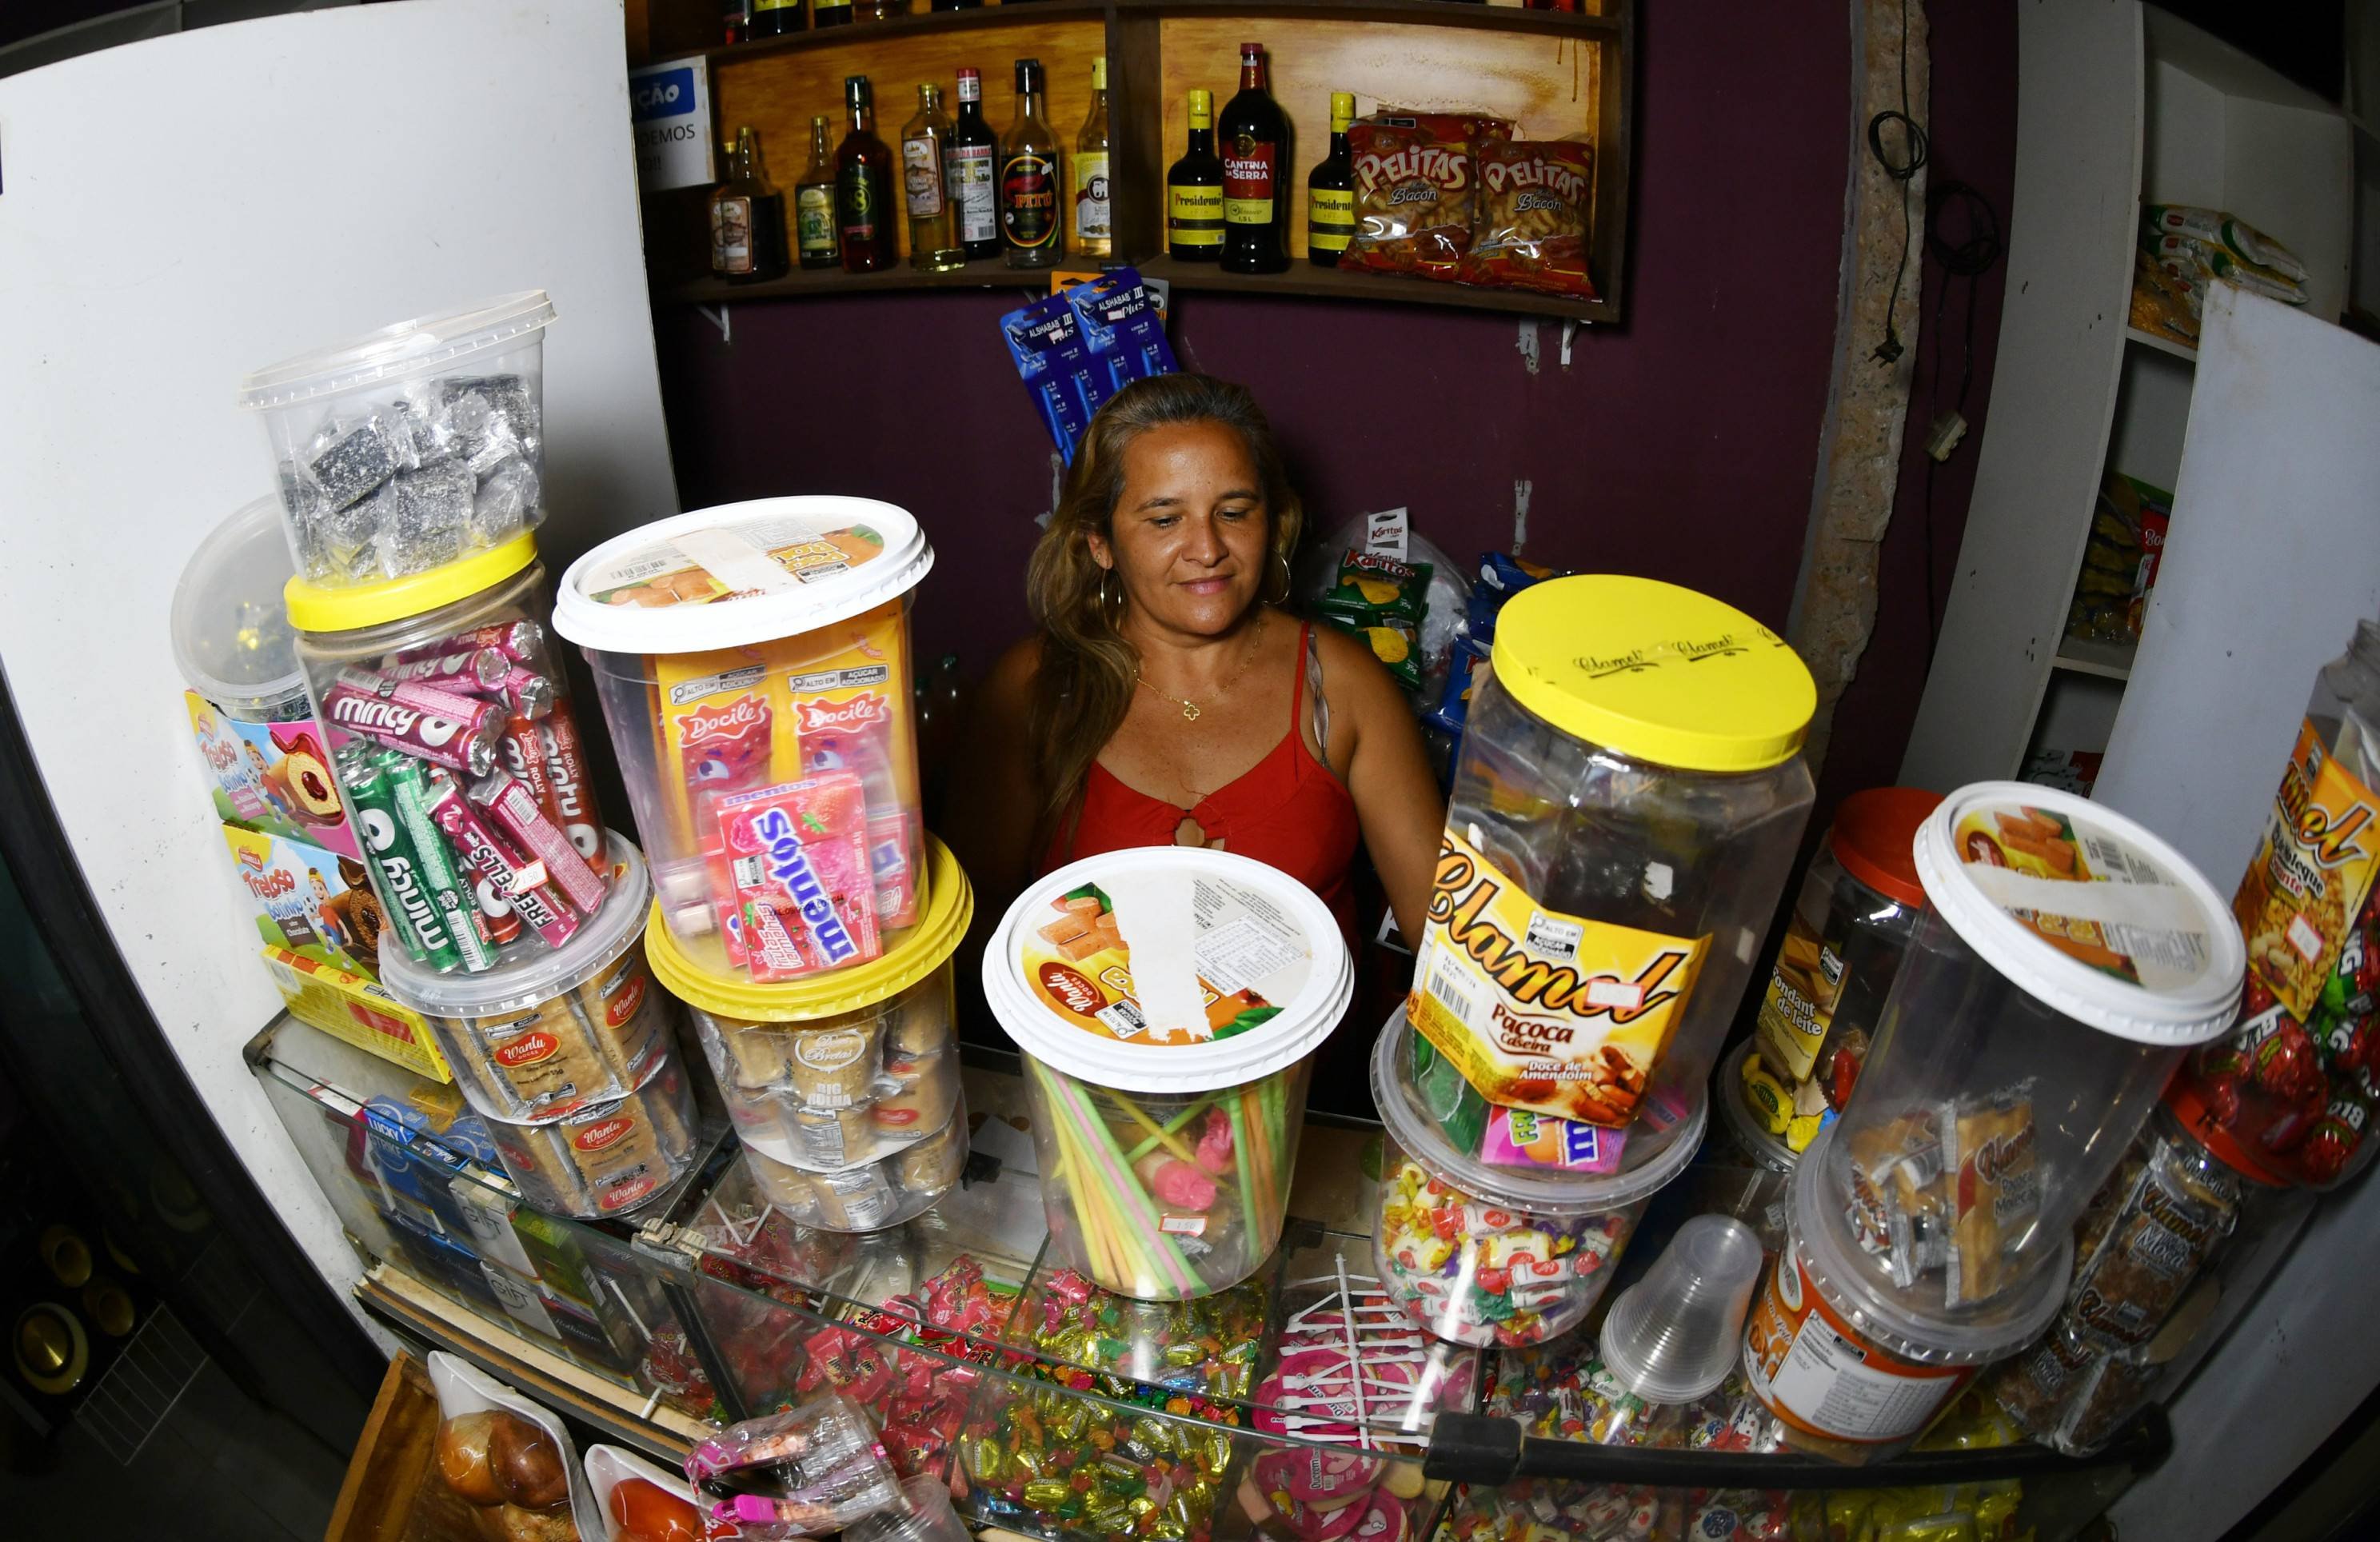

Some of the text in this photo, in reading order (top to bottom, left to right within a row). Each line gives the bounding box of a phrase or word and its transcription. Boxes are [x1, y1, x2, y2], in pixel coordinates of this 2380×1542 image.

[632, 82, 680, 111] ÇÃO
[636, 124, 696, 149] DEMOS
[1224, 158, 1268, 170] CANTINA
[1232, 170, 1268, 180] SERRA
[1356, 144, 1468, 192] PELITAS
[1484, 157, 1585, 206] PELITAS
[1015, 189, 1053, 209] PITÚ
[1312, 197, 1352, 212] President
[1388, 186, 1438, 206] Bacon
[1515, 192, 1563, 212] Bacon
[1098, 293, 1130, 313] ALSHABAB
[1028, 318, 1060, 338] ALSHABAB
[1371, 526, 1404, 541] Karitos
[1344, 548, 1416, 577] Karitos
[687, 684, 705, 697] ALTO
[805, 678, 824, 688] ALTO
[334, 696, 421, 736] mincy
[689, 702, 756, 739] Docile
[806, 701, 877, 728] Docile
[565, 752, 581, 779] ROLLY
[529, 766, 547, 795] ROLLY
[459, 877, 477, 905] ROLLY
[755, 808, 857, 965] mentos
[381, 857, 449, 951] mincy
[1046, 972, 1093, 1012] Wanlu
[1491, 1003, 1575, 1044] Paçoca
[1776, 996, 1823, 1037] de leite
[504, 1035, 545, 1060] Wanlu
[1499, 1032, 1551, 1053] Caseira
[1519, 1069, 1593, 1081] Amendoim
[1528, 1061, 1582, 1071] Doce de
[368, 1117, 399, 1141] LUCKY
[584, 1121, 621, 1144] Wanlu
[609, 1180, 645, 1202] Wanlu
[462, 1206, 501, 1236] GIFT
[491, 1279, 530, 1307] GIFT
